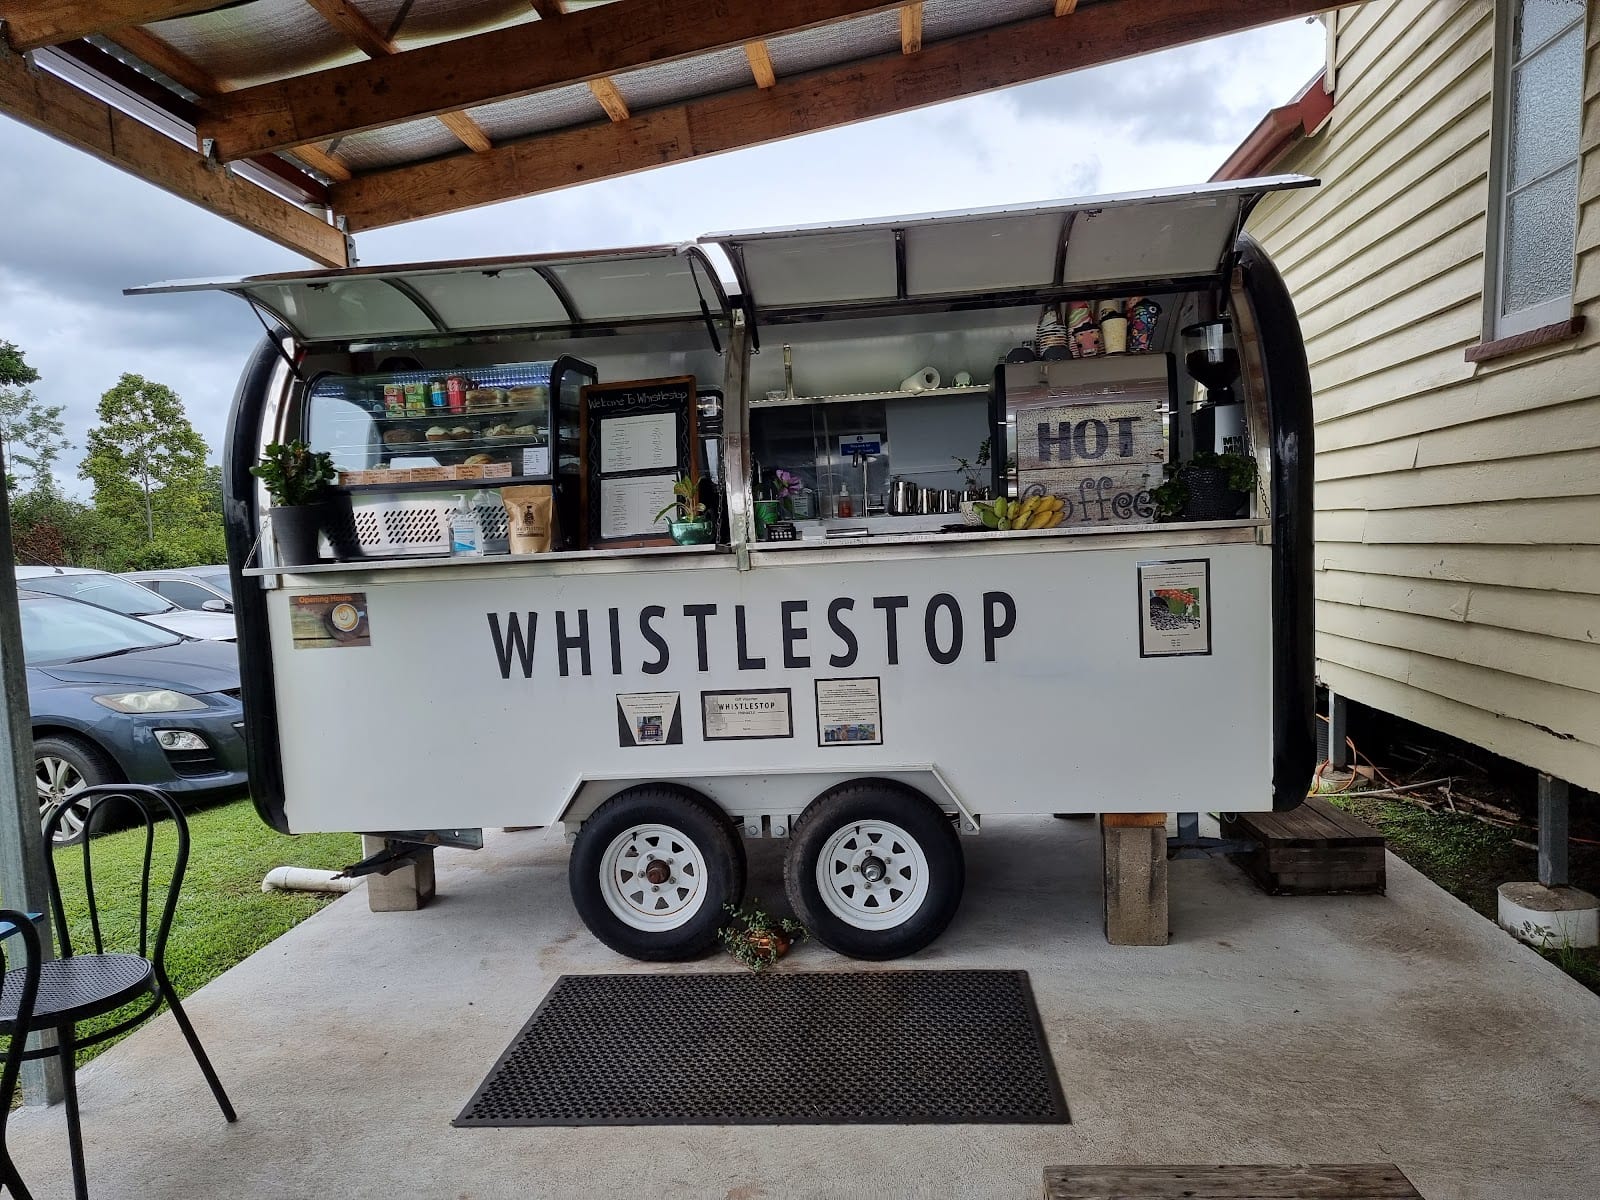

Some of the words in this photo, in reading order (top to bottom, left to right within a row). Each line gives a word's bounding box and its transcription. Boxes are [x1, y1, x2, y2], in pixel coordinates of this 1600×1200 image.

[588, 397, 624, 409] Welcome
[623, 393, 636, 405] To
[637, 390, 688, 403] Whistlestop
[1037, 416, 1141, 461] HOT
[298, 595, 329, 604] Opening
[331, 594, 352, 602] Hours
[486, 590, 1017, 679] WHISTLESTOP
[718, 702, 775, 710] WHISTLESTOP
